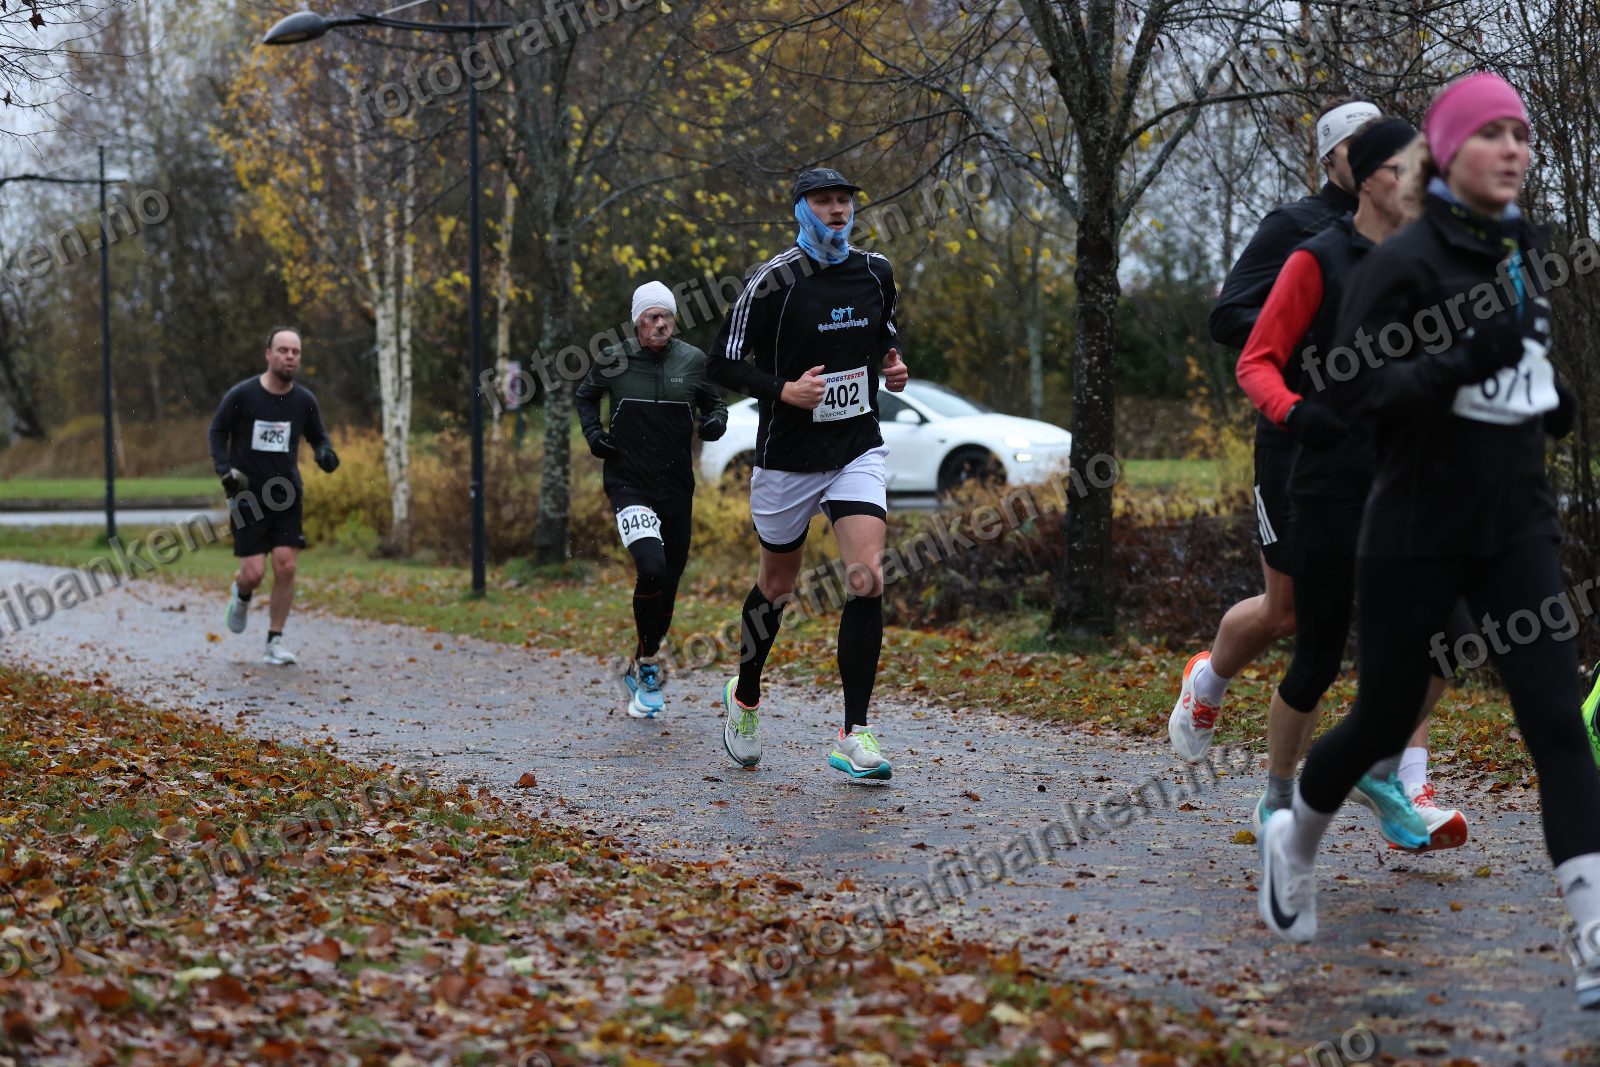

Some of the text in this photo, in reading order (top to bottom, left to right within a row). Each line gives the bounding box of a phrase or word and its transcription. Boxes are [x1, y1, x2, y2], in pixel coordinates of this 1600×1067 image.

[824, 382, 860, 410] 402
[260, 430, 284, 444] 426
[621, 513, 658, 536] 9482
